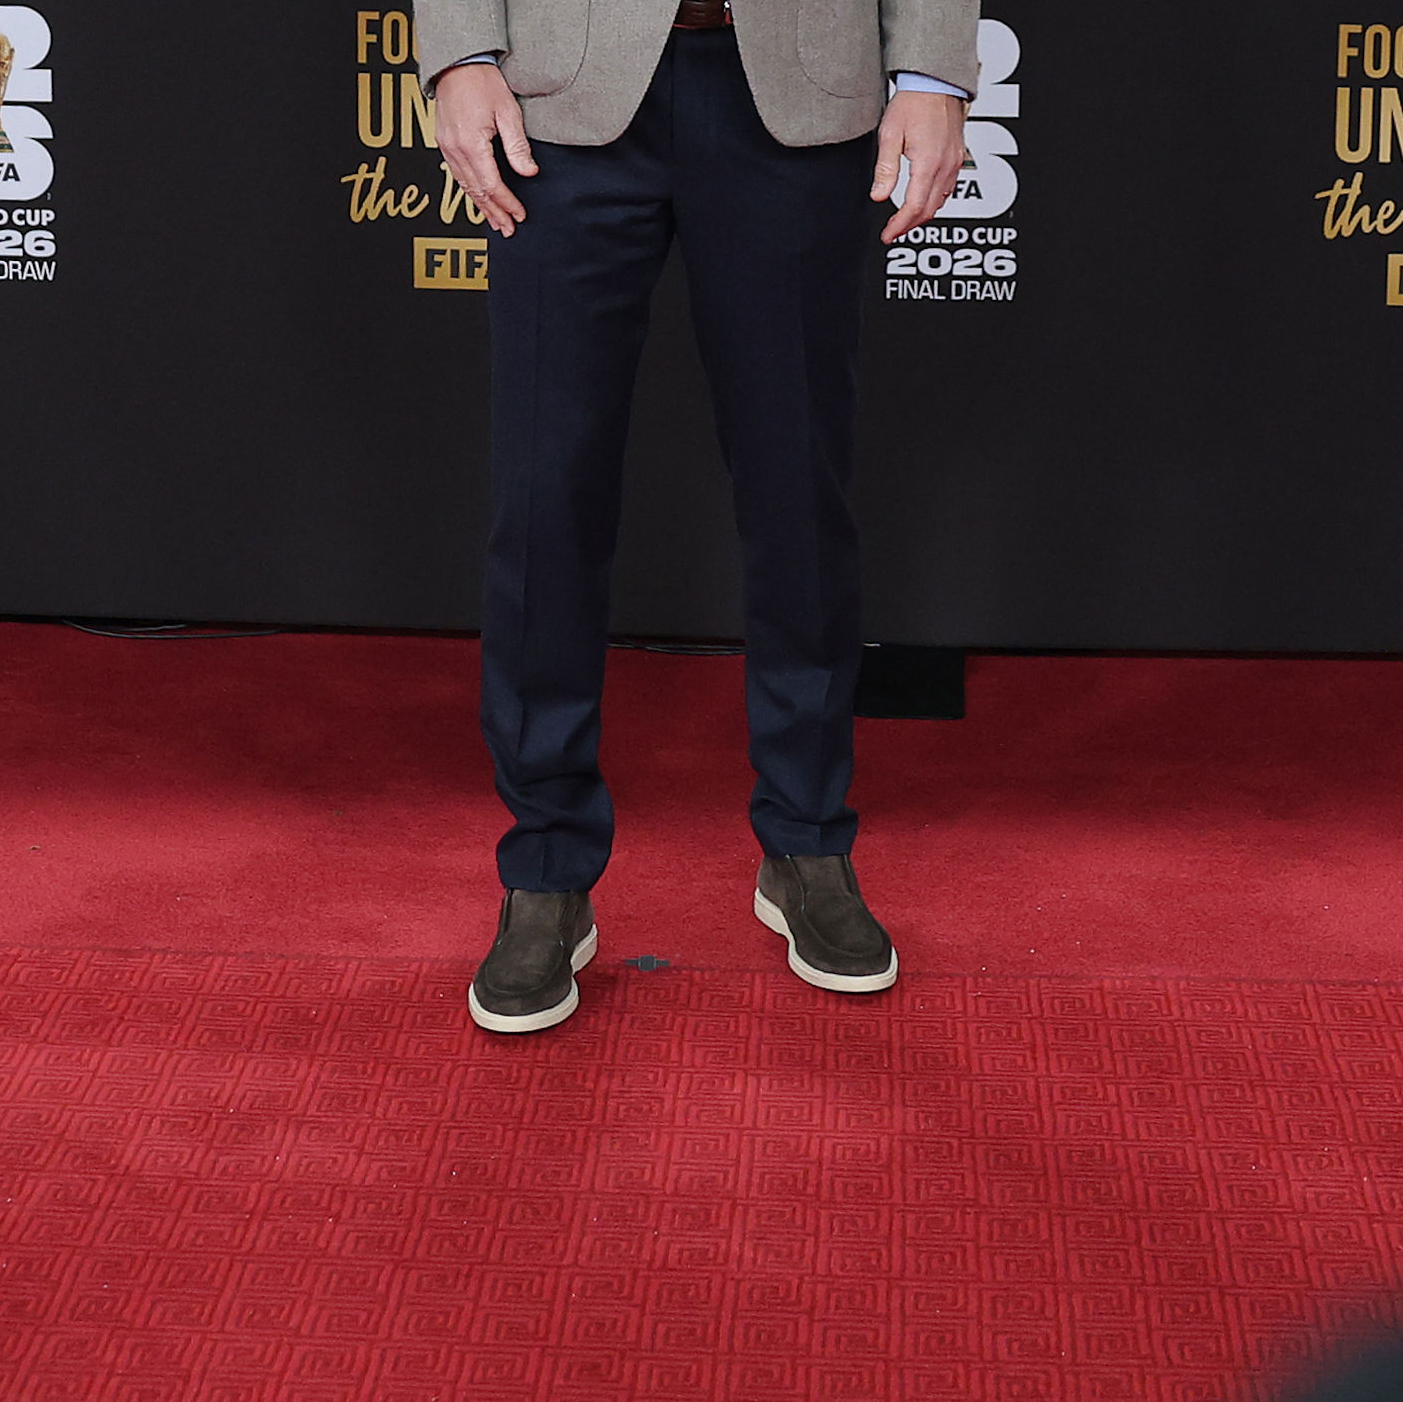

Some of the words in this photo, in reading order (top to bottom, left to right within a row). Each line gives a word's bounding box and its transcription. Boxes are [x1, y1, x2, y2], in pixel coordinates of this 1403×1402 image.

[341, 156, 429, 224] the
[12, 209, 55, 226] CUP
[972, 227, 1017, 245] CUP
[425, 249, 488, 279] FIF
[886, 247, 1017, 277] 2026
[885, 279, 946, 300] FINAL
[951, 280, 1016, 301] DRAW
